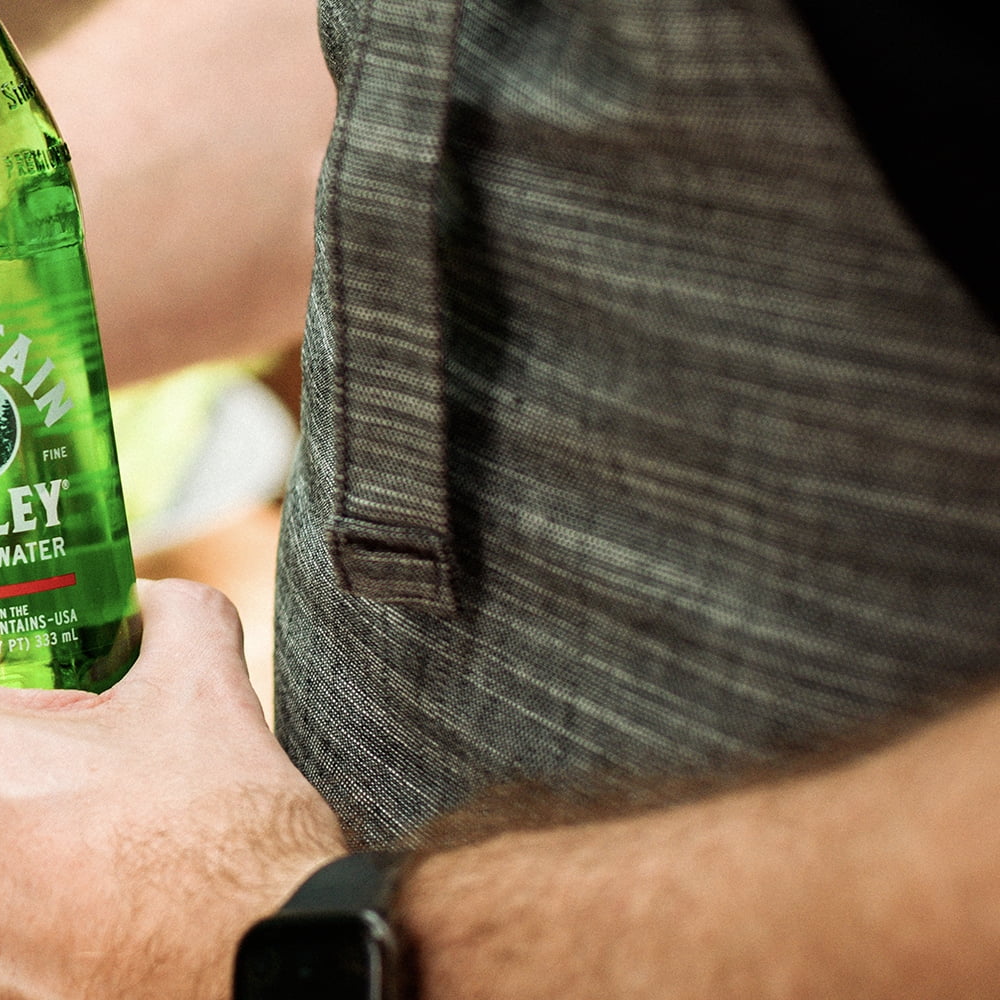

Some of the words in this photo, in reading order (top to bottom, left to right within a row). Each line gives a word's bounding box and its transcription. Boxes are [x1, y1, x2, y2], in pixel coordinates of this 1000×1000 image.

[43, 446, 68, 461] FINE
[9, 604, 29, 617] THE
[8, 637, 30, 653] PT)
[35, 632, 58, 649] 333
[62, 627, 79, 643] mL
